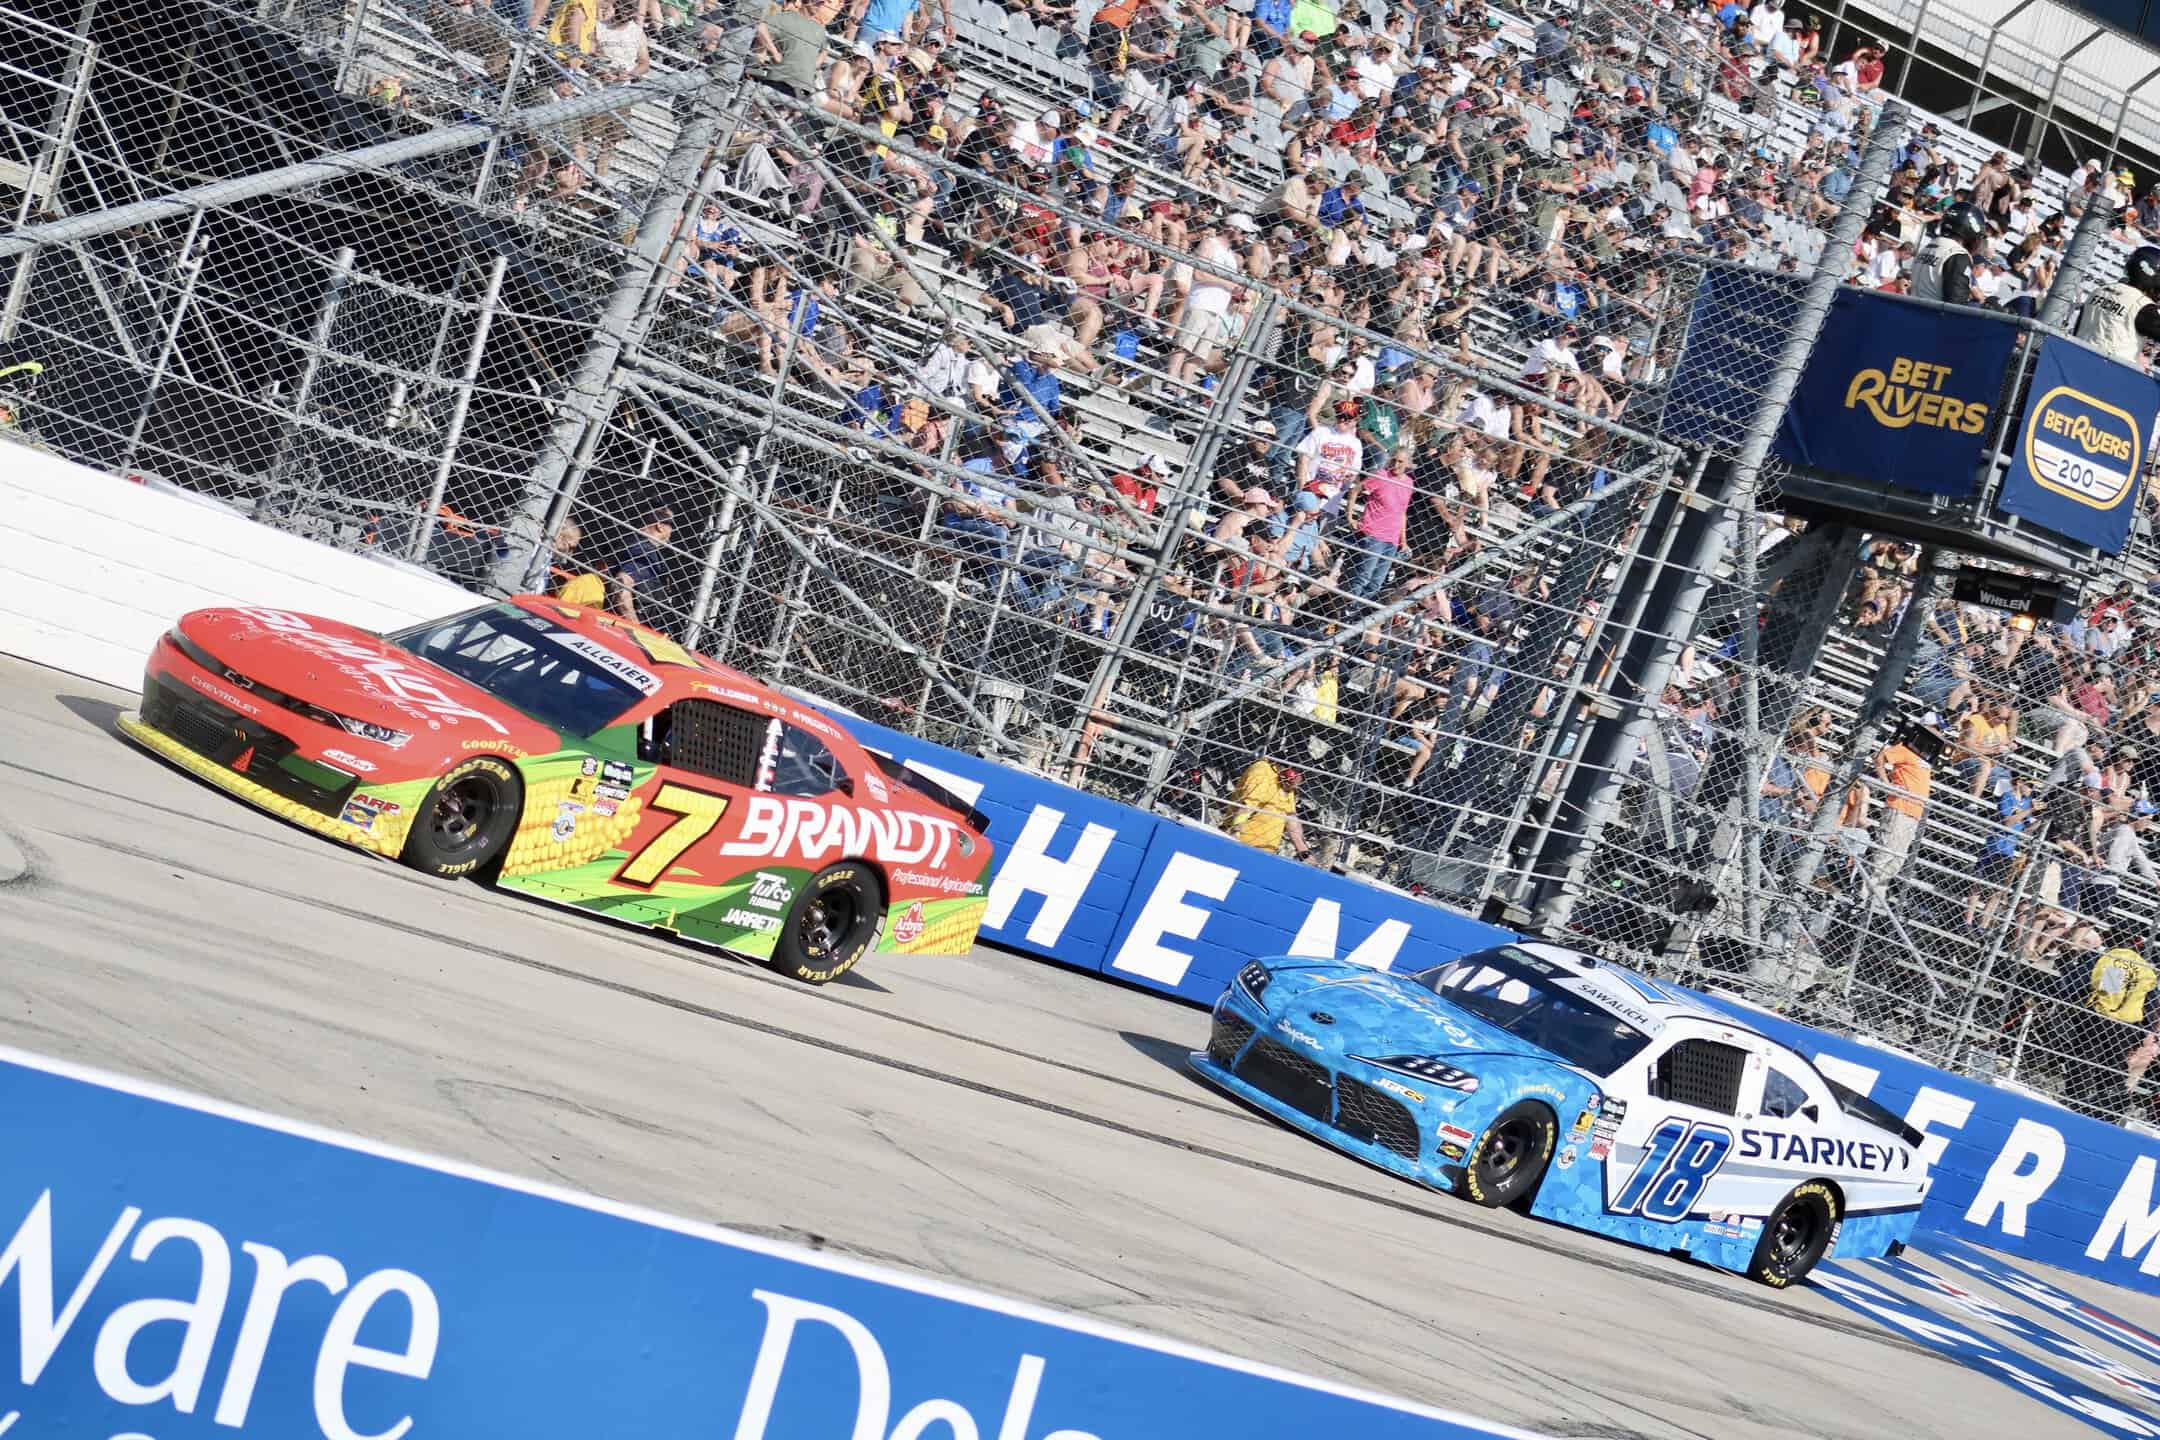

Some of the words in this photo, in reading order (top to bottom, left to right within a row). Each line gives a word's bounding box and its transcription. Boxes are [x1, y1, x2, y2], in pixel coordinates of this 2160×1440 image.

[1889, 356, 1953, 392] BET
[1844, 368, 1989, 434] RIVERS
[2058, 459, 2095, 488] 200
[570, 640, 653, 687] ALLGAIER
[190, 674, 262, 714] CHEVROLET
[461, 739, 528, 758] GOODYEAR
[437, 759, 512, 791] GOODYEAR
[352, 793, 400, 812] ARP
[611, 778, 733, 889] 7
[720, 796, 960, 868] BRANDT
[748, 871, 793, 902] Tufco
[818, 869, 856, 889] EAGLE
[720, 908, 784, 931] JARRETT
[797, 943, 865, 982] GOODYEAR
[1577, 982, 1649, 1025] SAWALICH
[1276, 1018, 1326, 1051] Supra
[1608, 1115, 1735, 1222] 18
[1739, 1128, 1894, 1172] STARKEY
